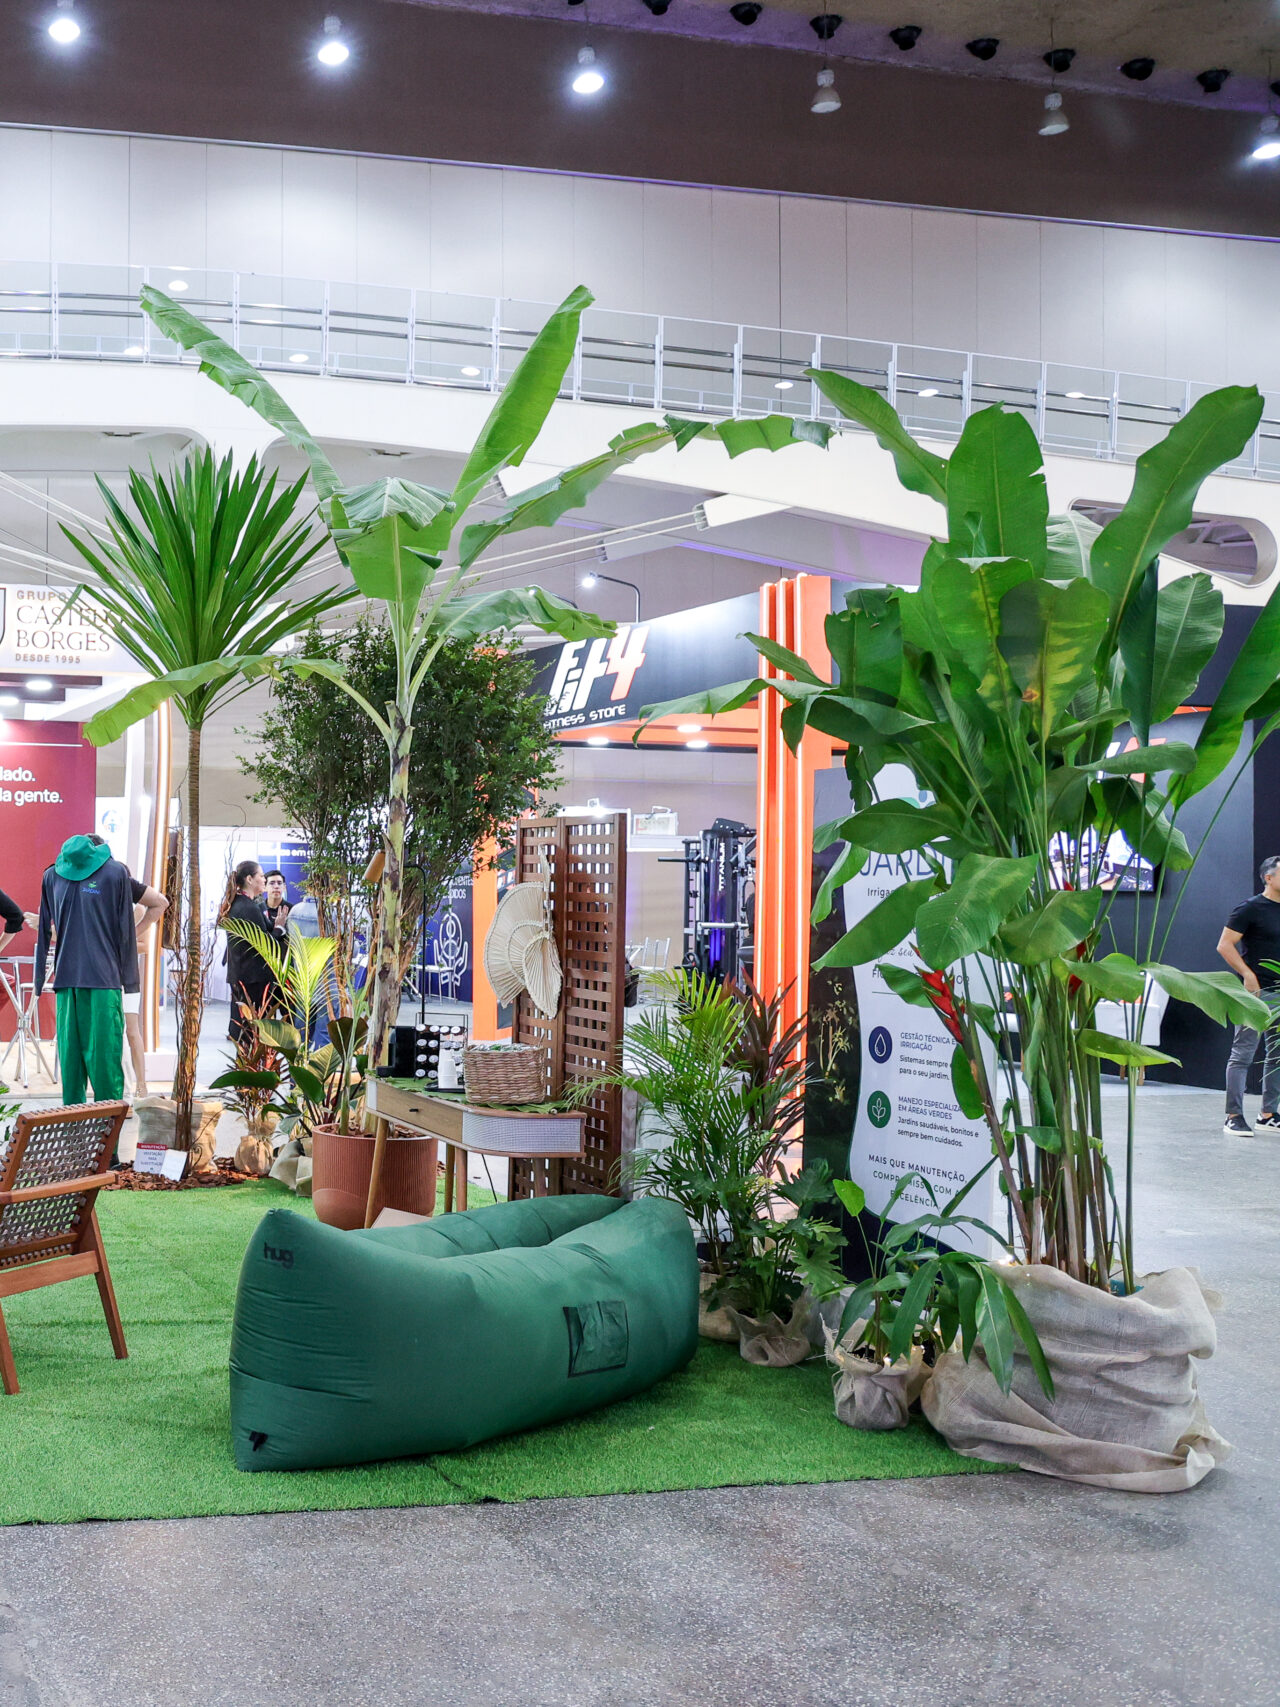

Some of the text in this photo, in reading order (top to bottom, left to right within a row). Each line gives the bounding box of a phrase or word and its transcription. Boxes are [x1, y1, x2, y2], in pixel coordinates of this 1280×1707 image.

[16, 590, 68, 601] GRUPO
[16, 604, 124, 628] CASTEL
[16, 629, 111, 652] BORGES
[15, 653, 81, 664] DESDE 1995
[14, 789, 63, 806] gente.
[900, 1031, 924, 1041] GESTÃO
[924, 1034, 951, 1045] TÉCNICA
[900, 1041, 933, 1052] IRRIGAÇÃO
[899, 1054, 949, 1069] Sistemas sempre
[899, 1067, 912, 1076] para
[898, 1096, 924, 1106] MANEJO
[908, 1105, 928, 1116] ÁREAS
[928, 1110, 953, 1120] VERDES
[898, 1116, 919, 1127] Jardins
[950, 1124, 974, 1136] bonitos
[897, 1129, 920, 1139] sempre
[920, 1133, 934, 1141] bem
[868, 1154, 887, 1165] MAIS
[889, 1158, 906, 1170] QUE
[933, 1184, 952, 1196] COM
[890, 1189, 941, 1210] ECELÊNCIA.
[264, 1241, 294, 1270] hug
